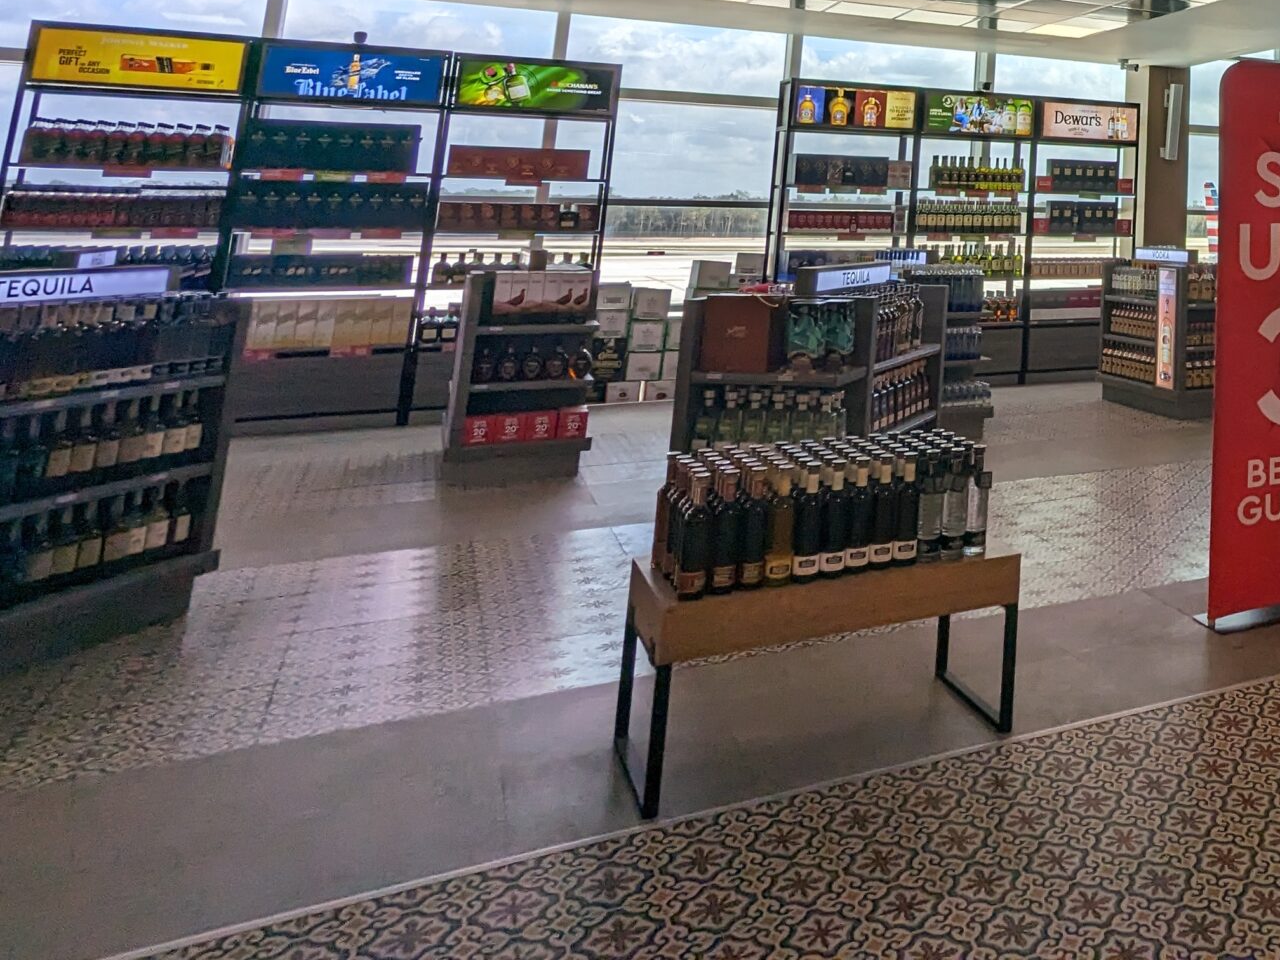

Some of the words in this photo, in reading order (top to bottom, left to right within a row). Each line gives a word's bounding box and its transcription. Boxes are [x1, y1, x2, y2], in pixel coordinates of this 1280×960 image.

[58, 48, 88, 57] PERFECT
[58, 56, 80, 66] GIFT
[78, 66, 110, 74] OCCASION
[1055, 110, 1102, 127] Dewar's
[1152, 251, 1169, 260] VODKA
[842, 271, 870, 286] TEQUILA
